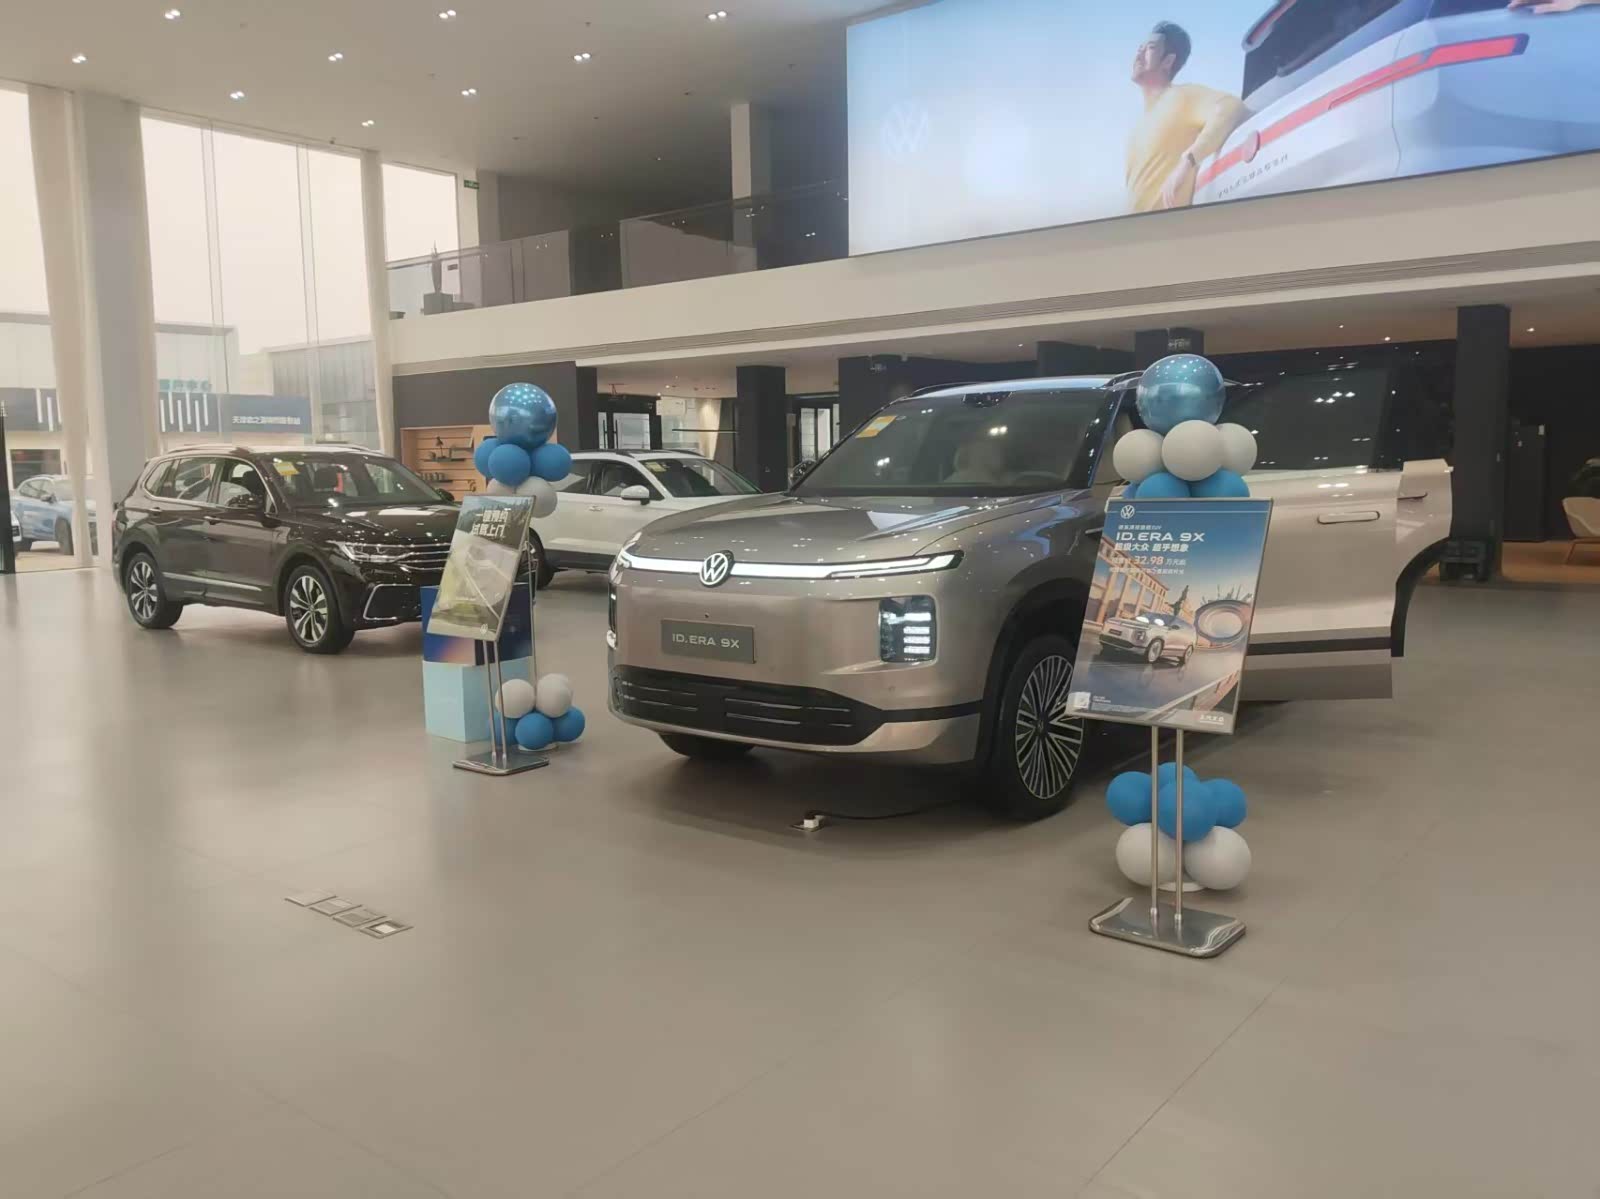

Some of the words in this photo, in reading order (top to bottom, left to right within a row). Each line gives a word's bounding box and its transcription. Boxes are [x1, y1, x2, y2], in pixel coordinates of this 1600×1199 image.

[1116, 532, 1174, 542] ID.ERA
[1180, 532, 1205, 542] 9X
[1133, 555, 1164, 565] 32.98
[672, 633, 716, 647] ID.ERA
[721, 638, 740, 649] 9X
